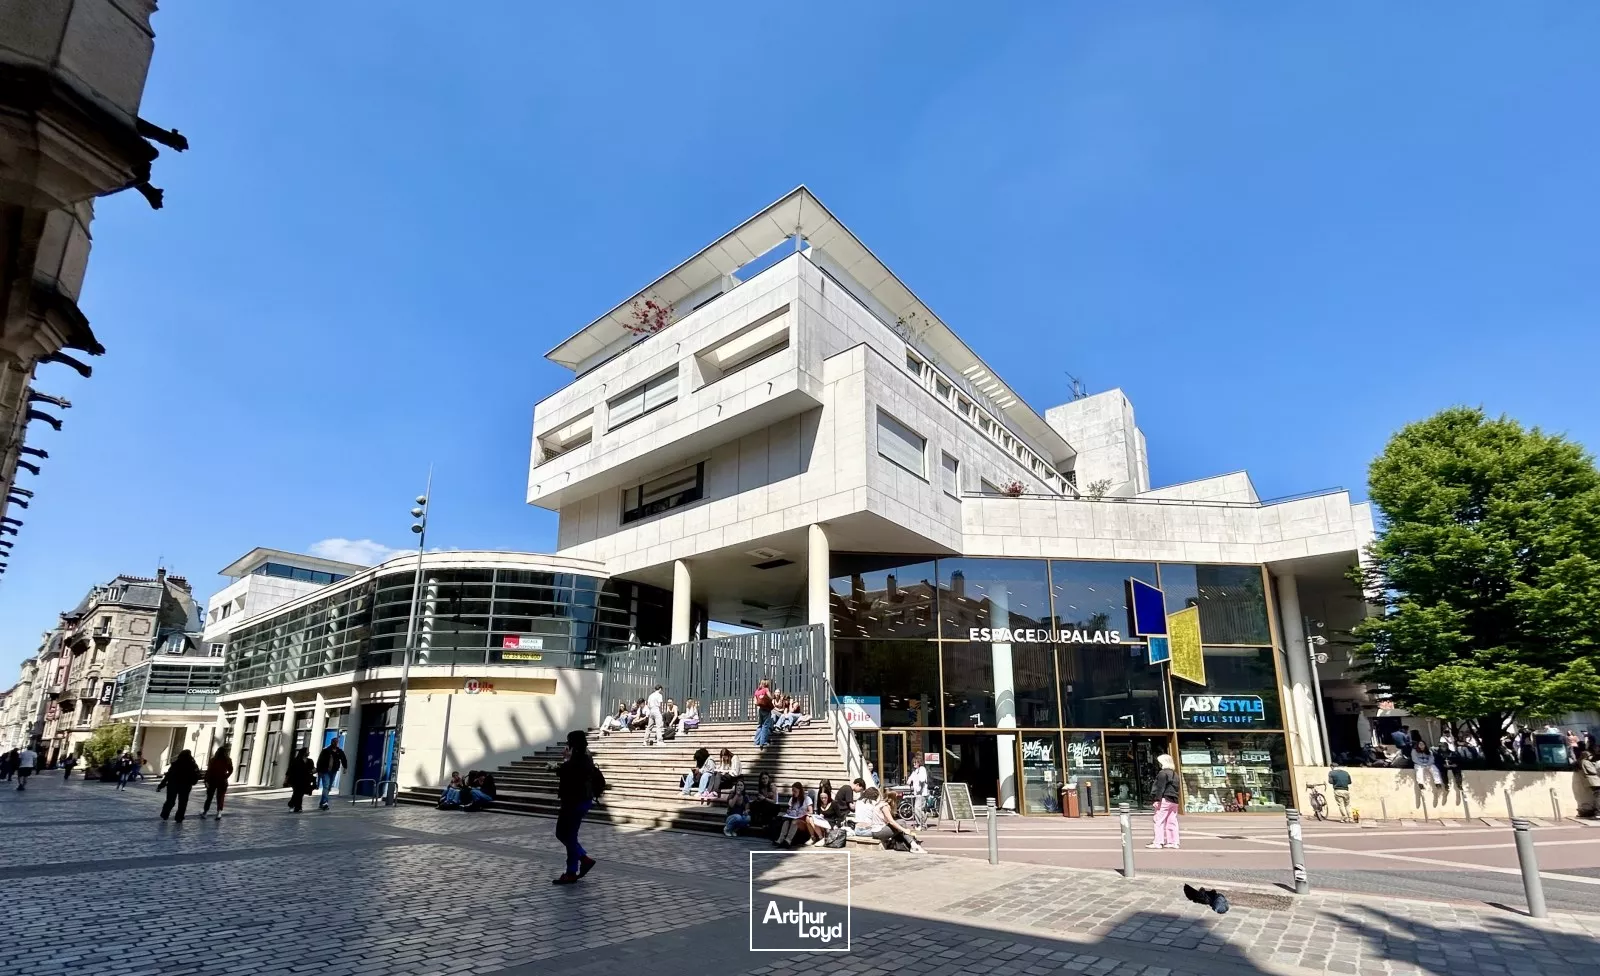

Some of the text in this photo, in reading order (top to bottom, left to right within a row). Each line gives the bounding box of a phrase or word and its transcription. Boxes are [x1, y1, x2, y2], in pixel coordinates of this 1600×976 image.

[101, 685, 112, 702] fnac
[843, 696, 865, 704] Entrée
[1193, 715, 1253, 723] FULL STUFF
